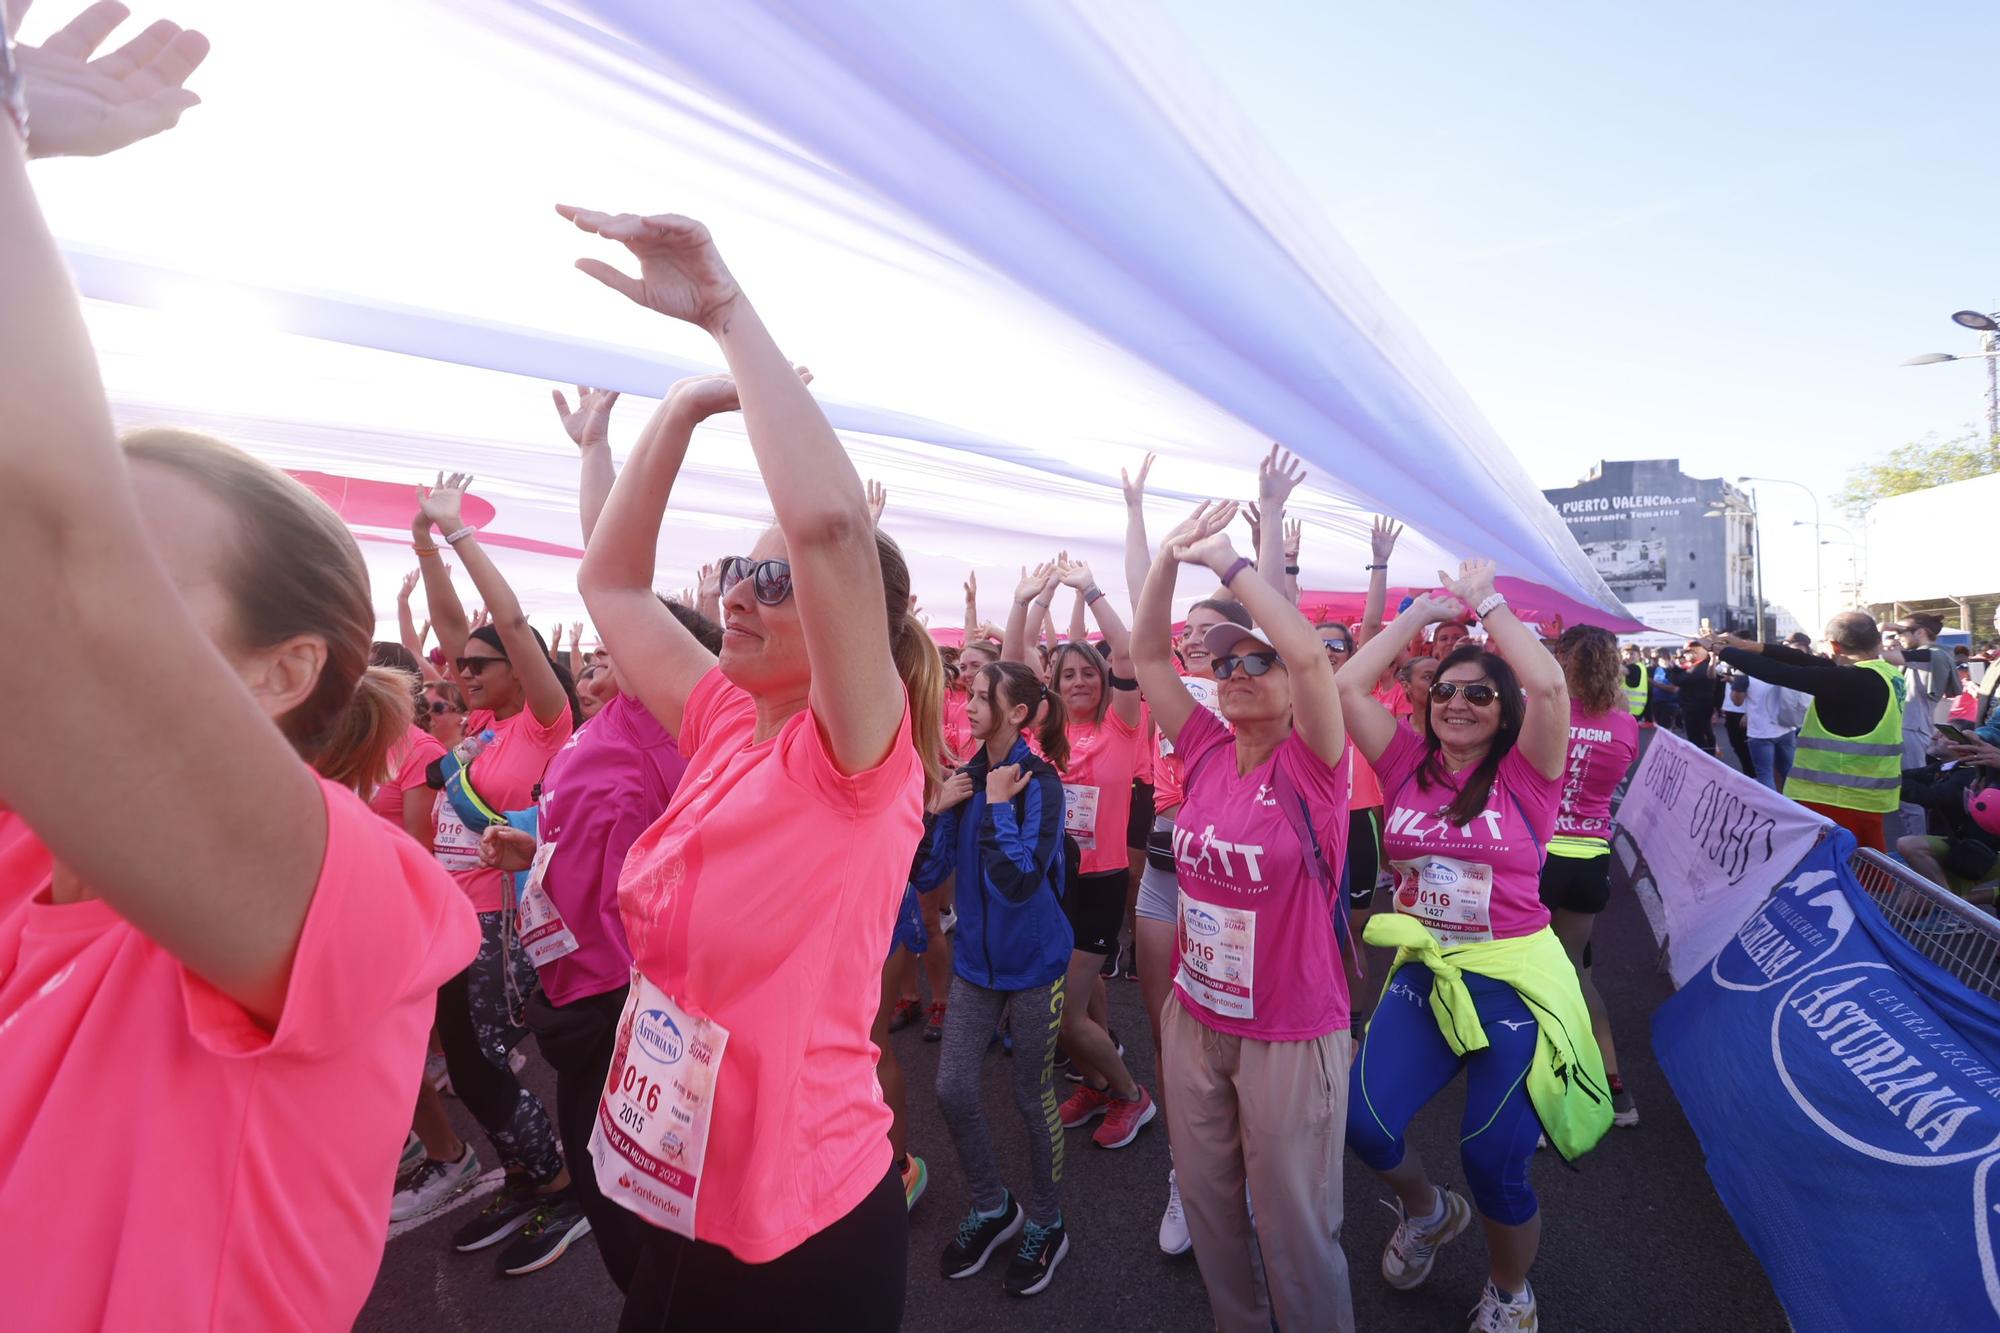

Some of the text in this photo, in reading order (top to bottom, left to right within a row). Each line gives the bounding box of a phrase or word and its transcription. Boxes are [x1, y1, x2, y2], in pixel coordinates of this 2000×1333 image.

[1563, 497, 1609, 513] PUERTO
[1569, 727, 1612, 743] TACHA
[439, 822, 463, 834] 016
[1690, 779, 1776, 886] OYSHO
[1247, 885, 1269, 895] TEAM
[1420, 890, 1451, 907] 016
[1424, 907, 1444, 917] 1427
[1225, 921, 1246, 932] SUMA
[1189, 938, 1214, 960] 016
[1192, 958, 1208, 972] 1426
[1868, 988, 1934, 1040] CENTRAL
[637, 1017, 678, 1059] ASTURIANA
[689, 1042, 711, 1067] SUMA
[1789, 976, 1982, 1152] ASTURIANA
[623, 1065, 661, 1112] 016
[619, 1102, 645, 1134] 2015
[611, 1132, 621, 1146] DE
[620, 1139, 630, 1155] LA
[630, 1147, 656, 1173] MUJER
[658, 1166, 682, 1187] 2023
[631, 1180, 681, 1217] Santander
